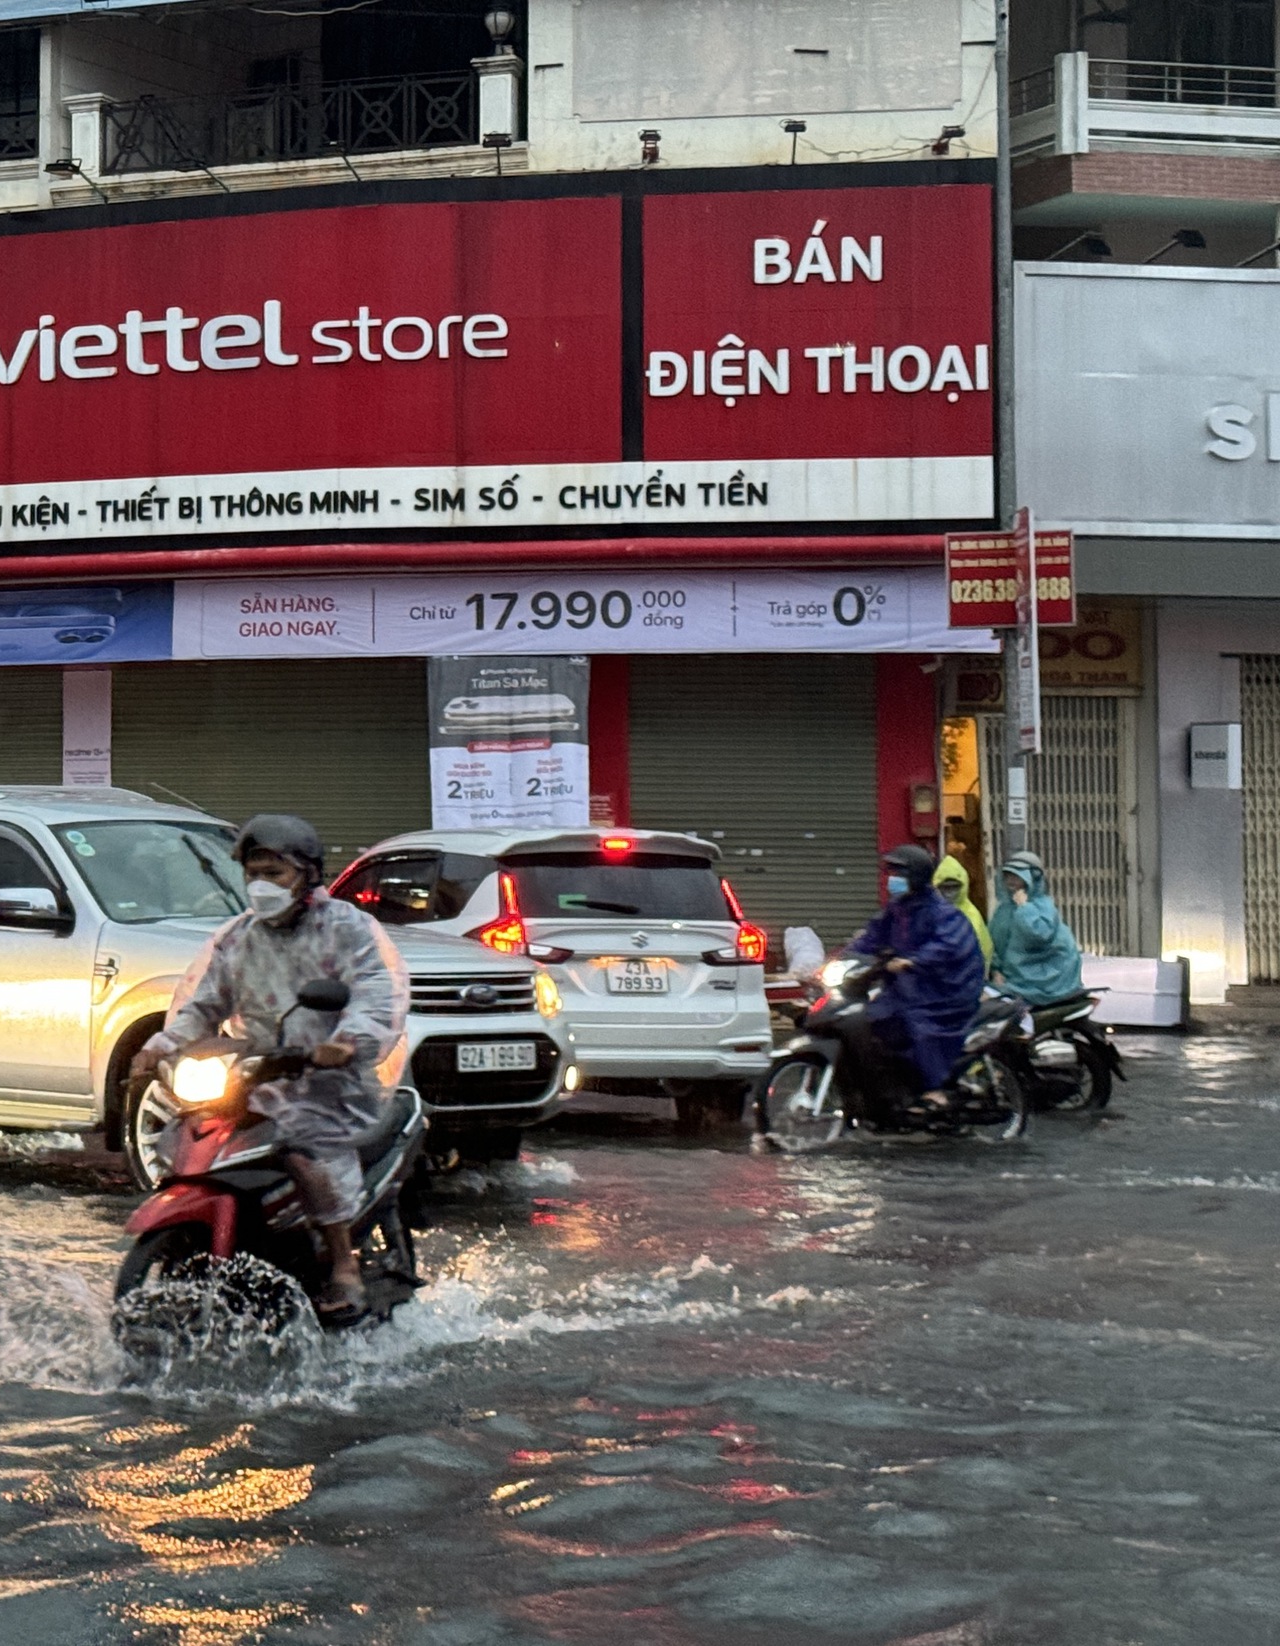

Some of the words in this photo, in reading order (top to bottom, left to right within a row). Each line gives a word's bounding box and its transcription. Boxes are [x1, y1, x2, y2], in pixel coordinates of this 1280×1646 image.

[754, 219, 883, 284] BÁN
[312, 306, 508, 364] store
[645, 333, 790, 407] ĐIỆN
[804, 344, 990, 403] THOẠI
[1203, 392, 1280, 461] S
[12, 495, 70, 531] KIỆN
[96, 485, 170, 523] THIẾT
[178, 496, 202, 524] BỊ
[209, 486, 303, 518] THÔNG
[310, 489, 379, 515] MINH
[414, 488, 465, 513] SIM
[478, 474, 520, 511] SỐ
[559, 470, 686, 510] CHUYỂN
[698, 470, 769, 507] TIỀN
[240, 592, 277, 614] SẴN
[281, 594, 339, 613] HÀNG.
[767, 600, 792, 615] Trả
[796, 600, 827, 619] góp
[409, 605, 436, 621] Chỉ
[439, 606, 457, 620] từ
[643, 610, 684, 630] đồng
[239, 621, 283, 637] GIAO
[288, 620, 340, 637] NGAY.
[472, 678, 502, 690] Titan
[503, 677, 519, 689] Sa
[447, 780, 462, 799] 2
[527, 778, 541, 796] 2
[625, 961, 651, 975] 43A
[616, 977, 663, 990] 789.93
